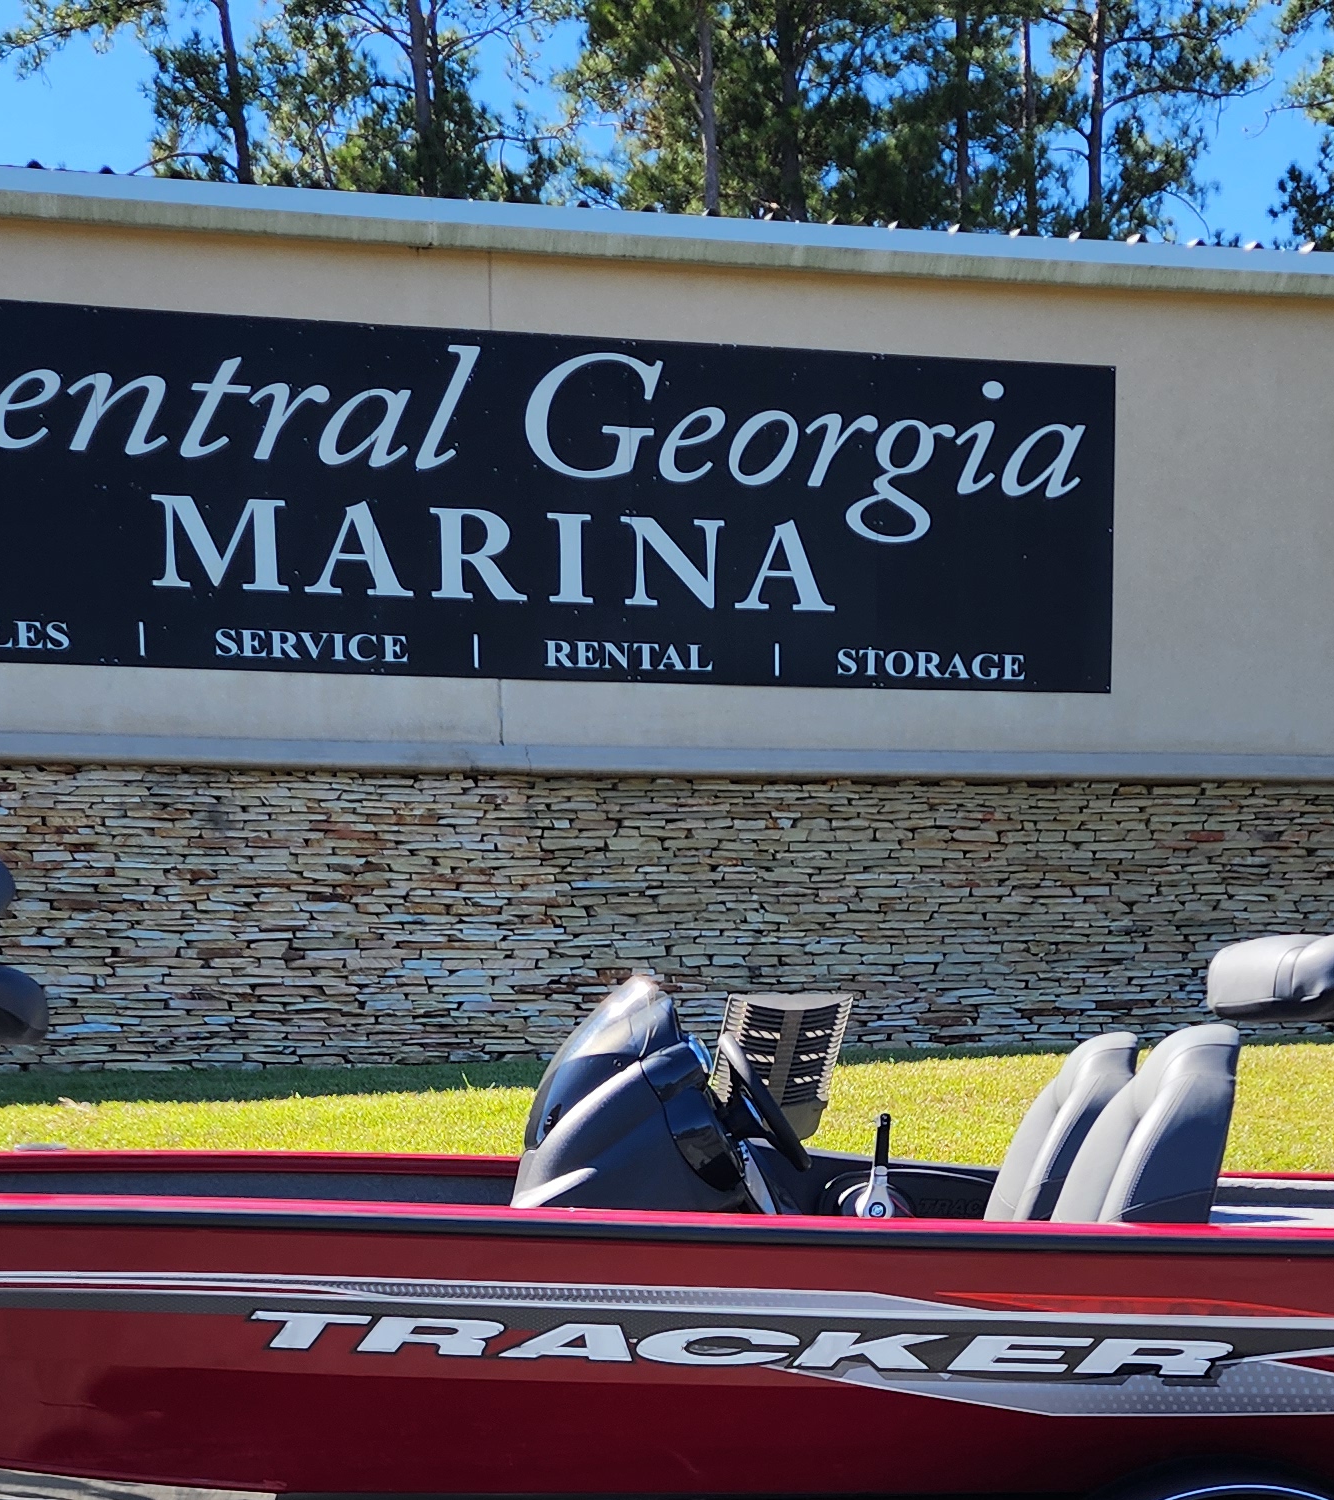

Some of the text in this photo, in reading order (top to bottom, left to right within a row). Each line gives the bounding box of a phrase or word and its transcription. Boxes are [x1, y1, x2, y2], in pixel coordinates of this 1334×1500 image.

[524, 351, 1086, 545] Georgia
[149, 493, 836, 613] MARINA
[214, 627, 409, 664] SERVICE
[543, 638, 712, 673] RENTAL
[835, 646, 1027, 682] STORAGE
[918, 1197, 983, 1215] TRAC
[249, 1309, 1234, 1377] TRACKER
